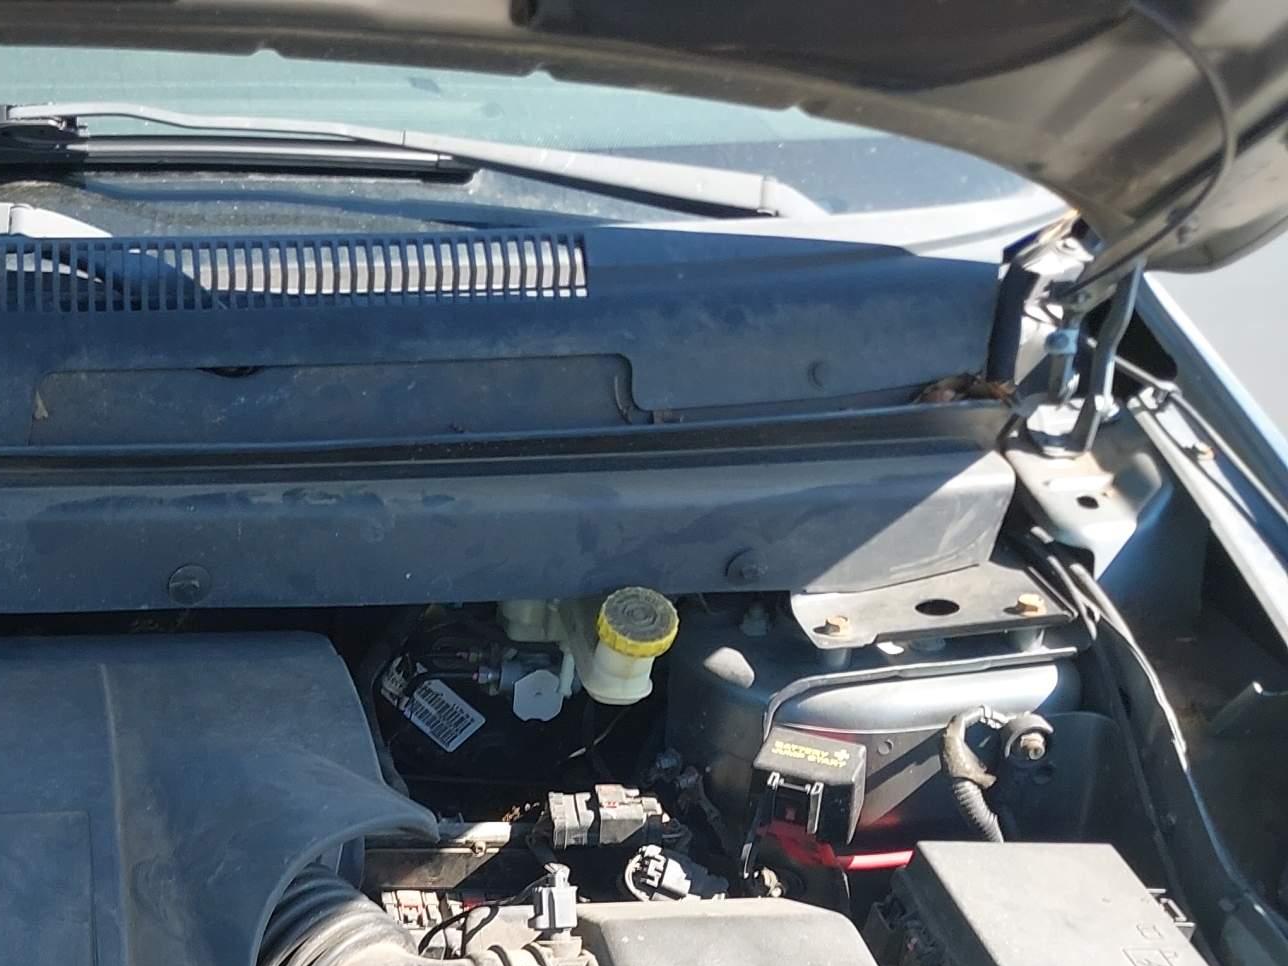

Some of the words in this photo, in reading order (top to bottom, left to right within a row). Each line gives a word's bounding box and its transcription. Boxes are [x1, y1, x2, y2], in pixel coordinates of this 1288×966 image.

[772, 747, 806, 759] JUMP
[807, 754, 846, 768] START
[774, 740, 829, 759] BATTERY
